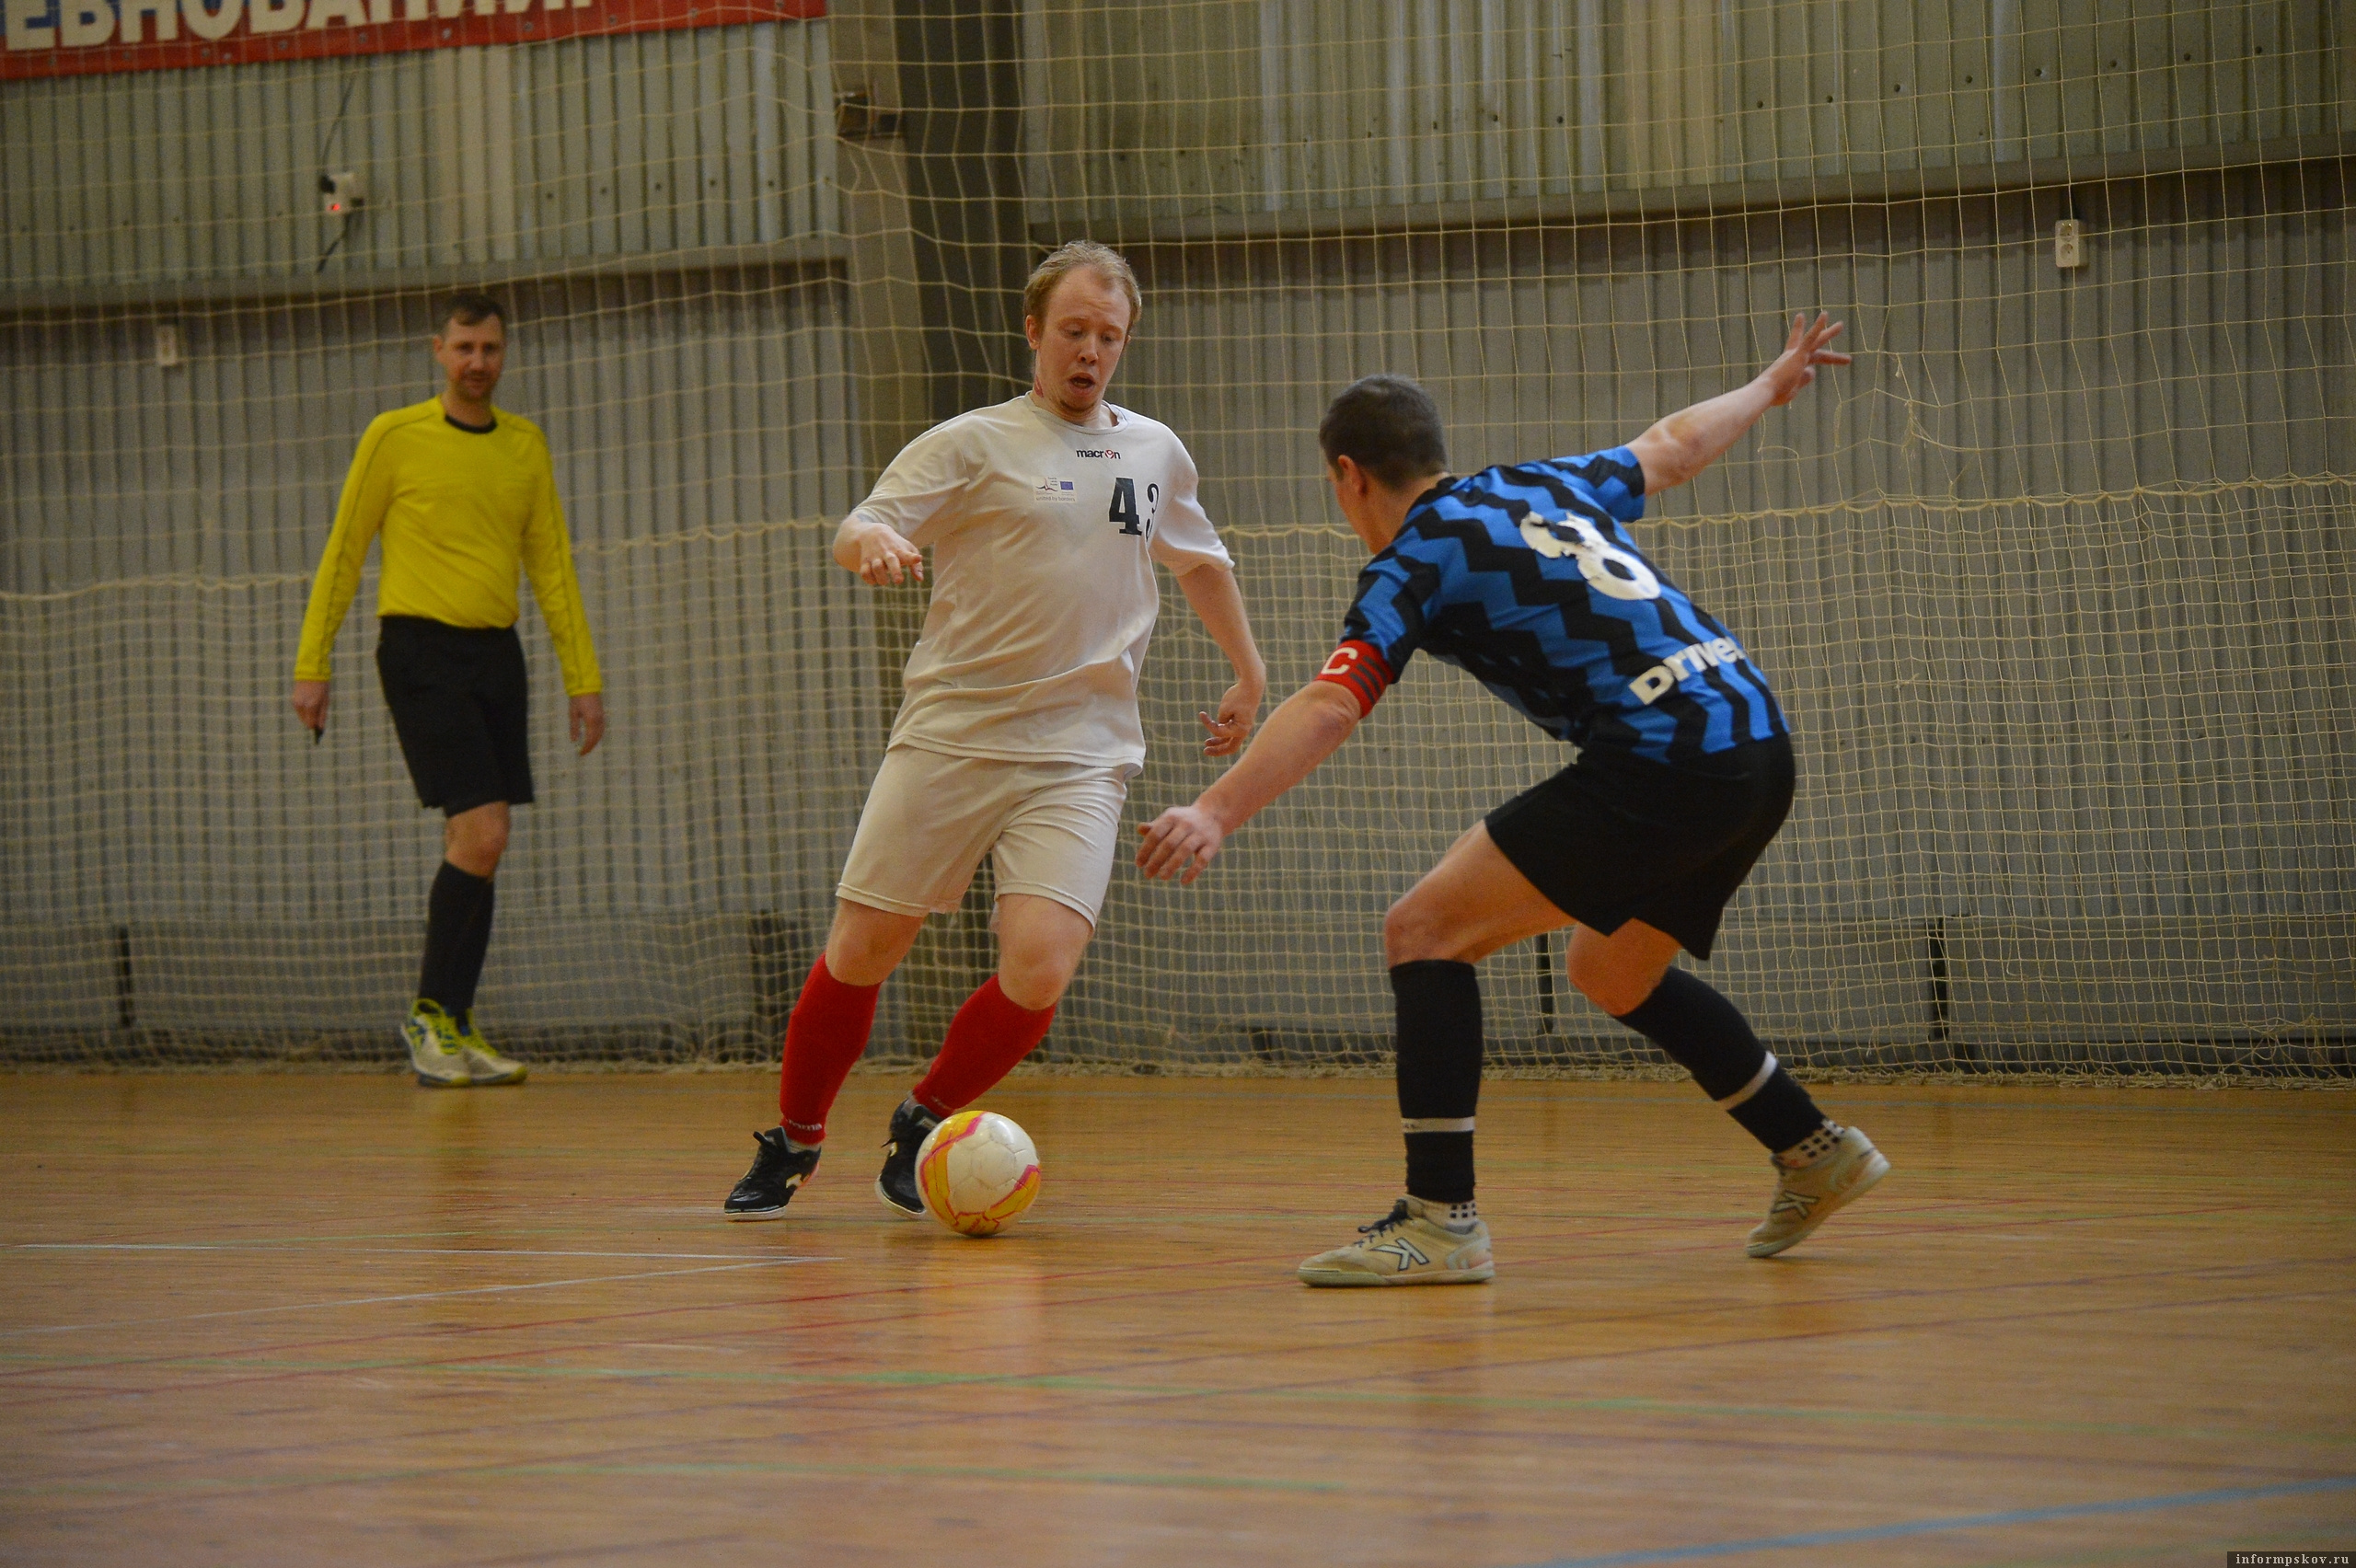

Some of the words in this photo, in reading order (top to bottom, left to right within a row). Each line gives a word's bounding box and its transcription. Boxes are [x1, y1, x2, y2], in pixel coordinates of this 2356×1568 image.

[1076, 448, 1121, 460] macron
[1519, 511, 1661, 600] 8
[1321, 647, 1358, 674] C
